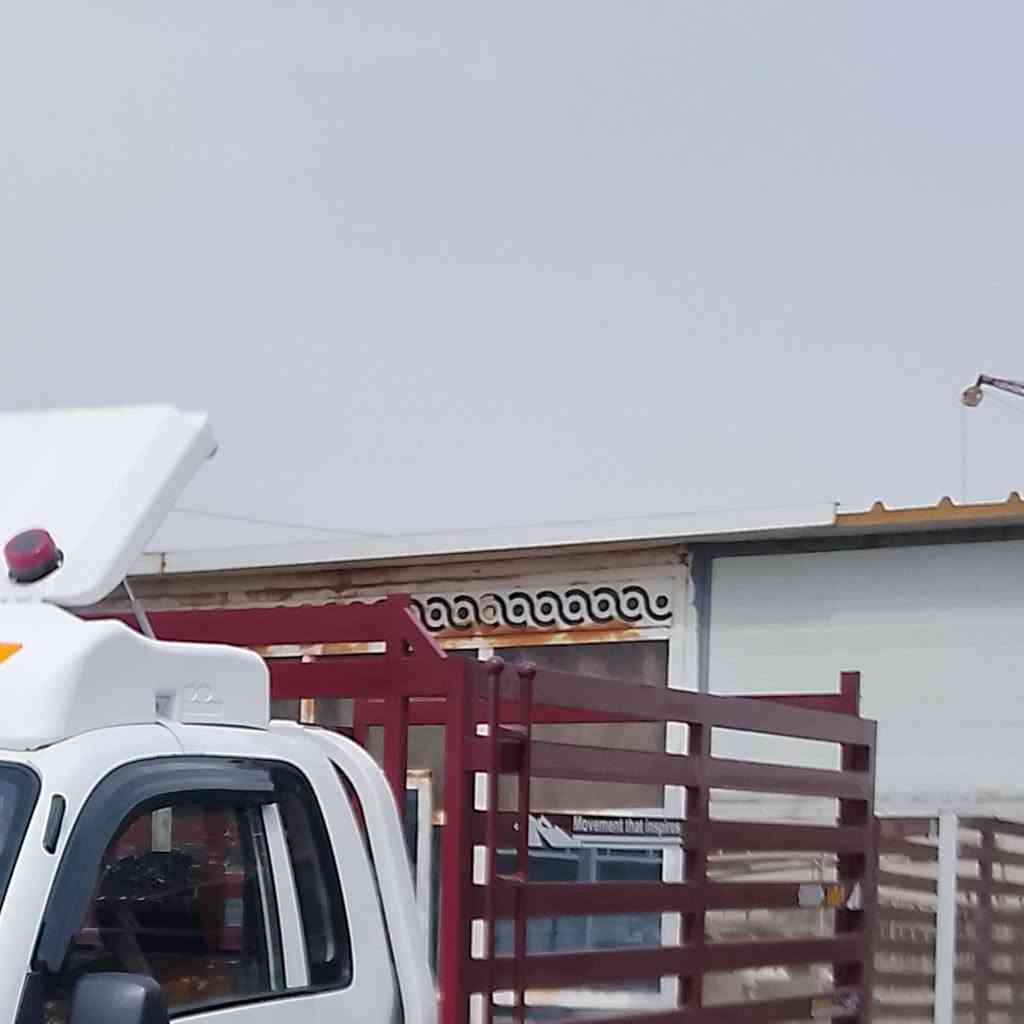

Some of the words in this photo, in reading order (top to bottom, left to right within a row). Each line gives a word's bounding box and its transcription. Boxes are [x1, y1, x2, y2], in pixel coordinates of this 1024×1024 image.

[573, 815, 624, 834] Movement
[625, 818, 644, 834] that
[645, 819, 680, 837] inspires
